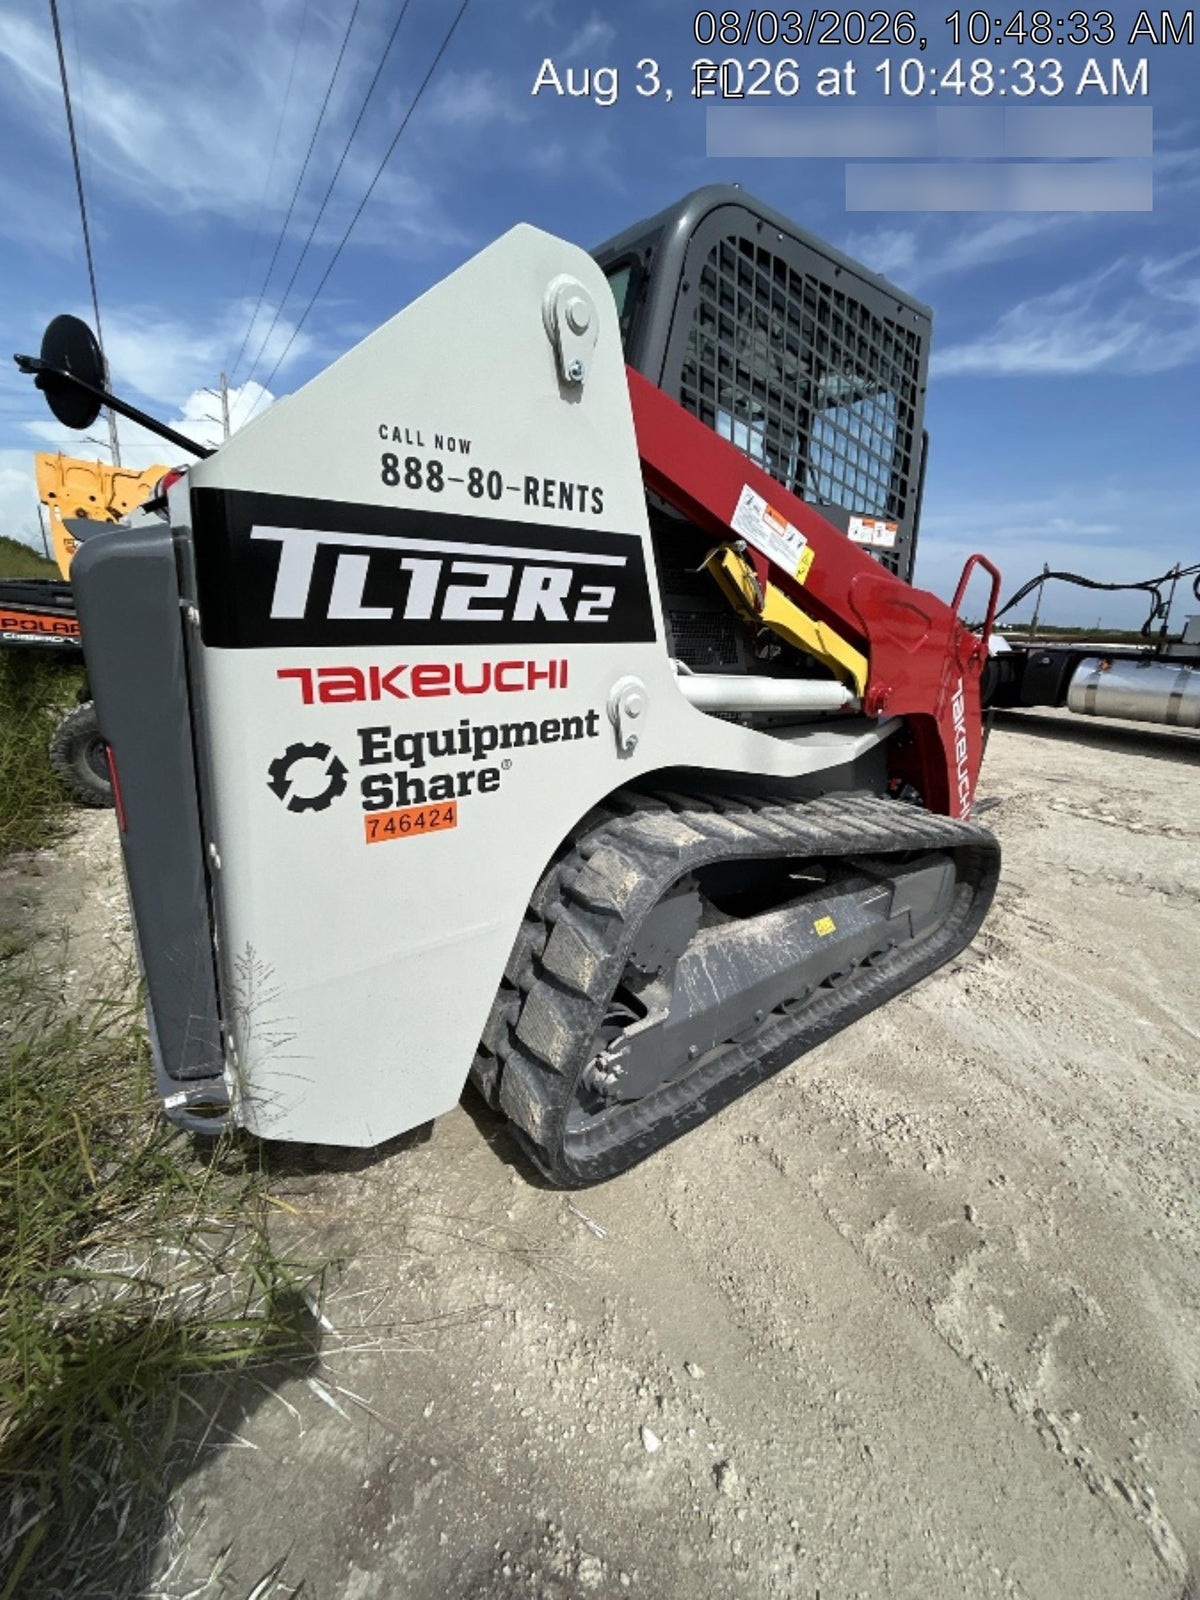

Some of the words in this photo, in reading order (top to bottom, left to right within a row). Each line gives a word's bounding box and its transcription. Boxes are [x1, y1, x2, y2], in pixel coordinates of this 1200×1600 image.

[379, 424, 424, 447] CALL
[435, 434, 472, 454] NOW
[380, 452, 604, 515] 888-80-RENTS
[250, 524, 627, 622] TL12R2
[277, 659, 568, 705] TAKEUCHI
[357, 709, 599, 769] Equipment
[367, 807, 454, 838] 746424
